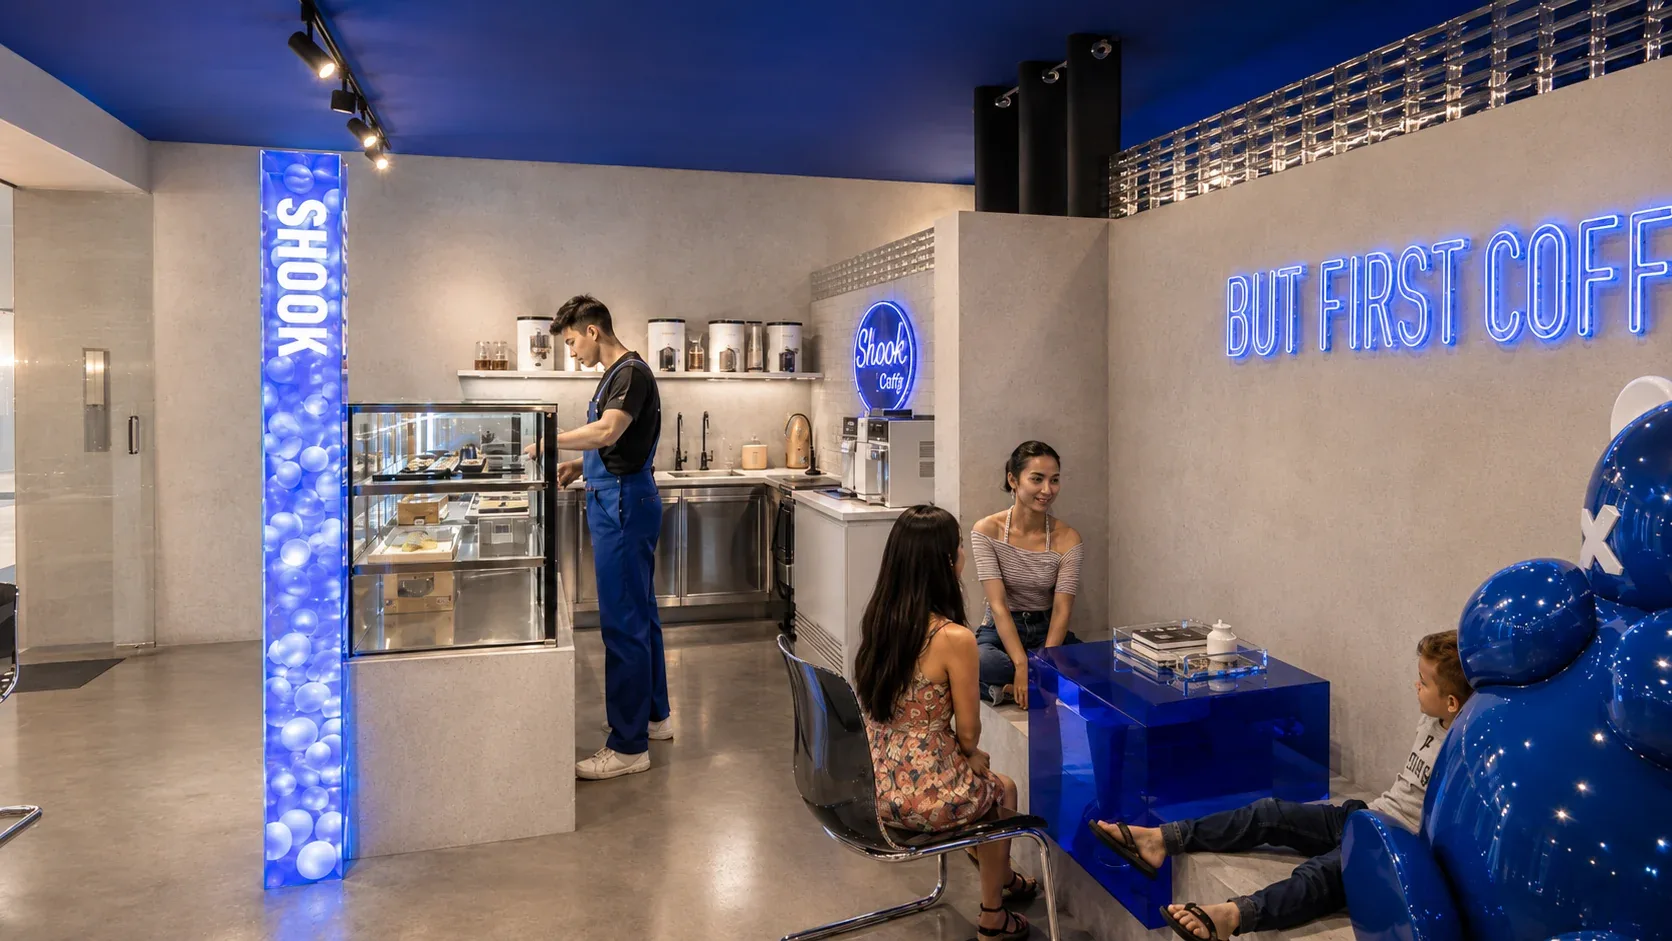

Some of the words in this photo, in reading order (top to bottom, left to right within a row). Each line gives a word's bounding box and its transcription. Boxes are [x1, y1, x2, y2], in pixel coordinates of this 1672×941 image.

[276, 198, 328, 357] SHOOK
[856, 321, 908, 368] Shook
[1226, 264, 1304, 357] BUT
[1319, 238, 1470, 348] FIRST
[1485, 205, 1672, 342] COFF
